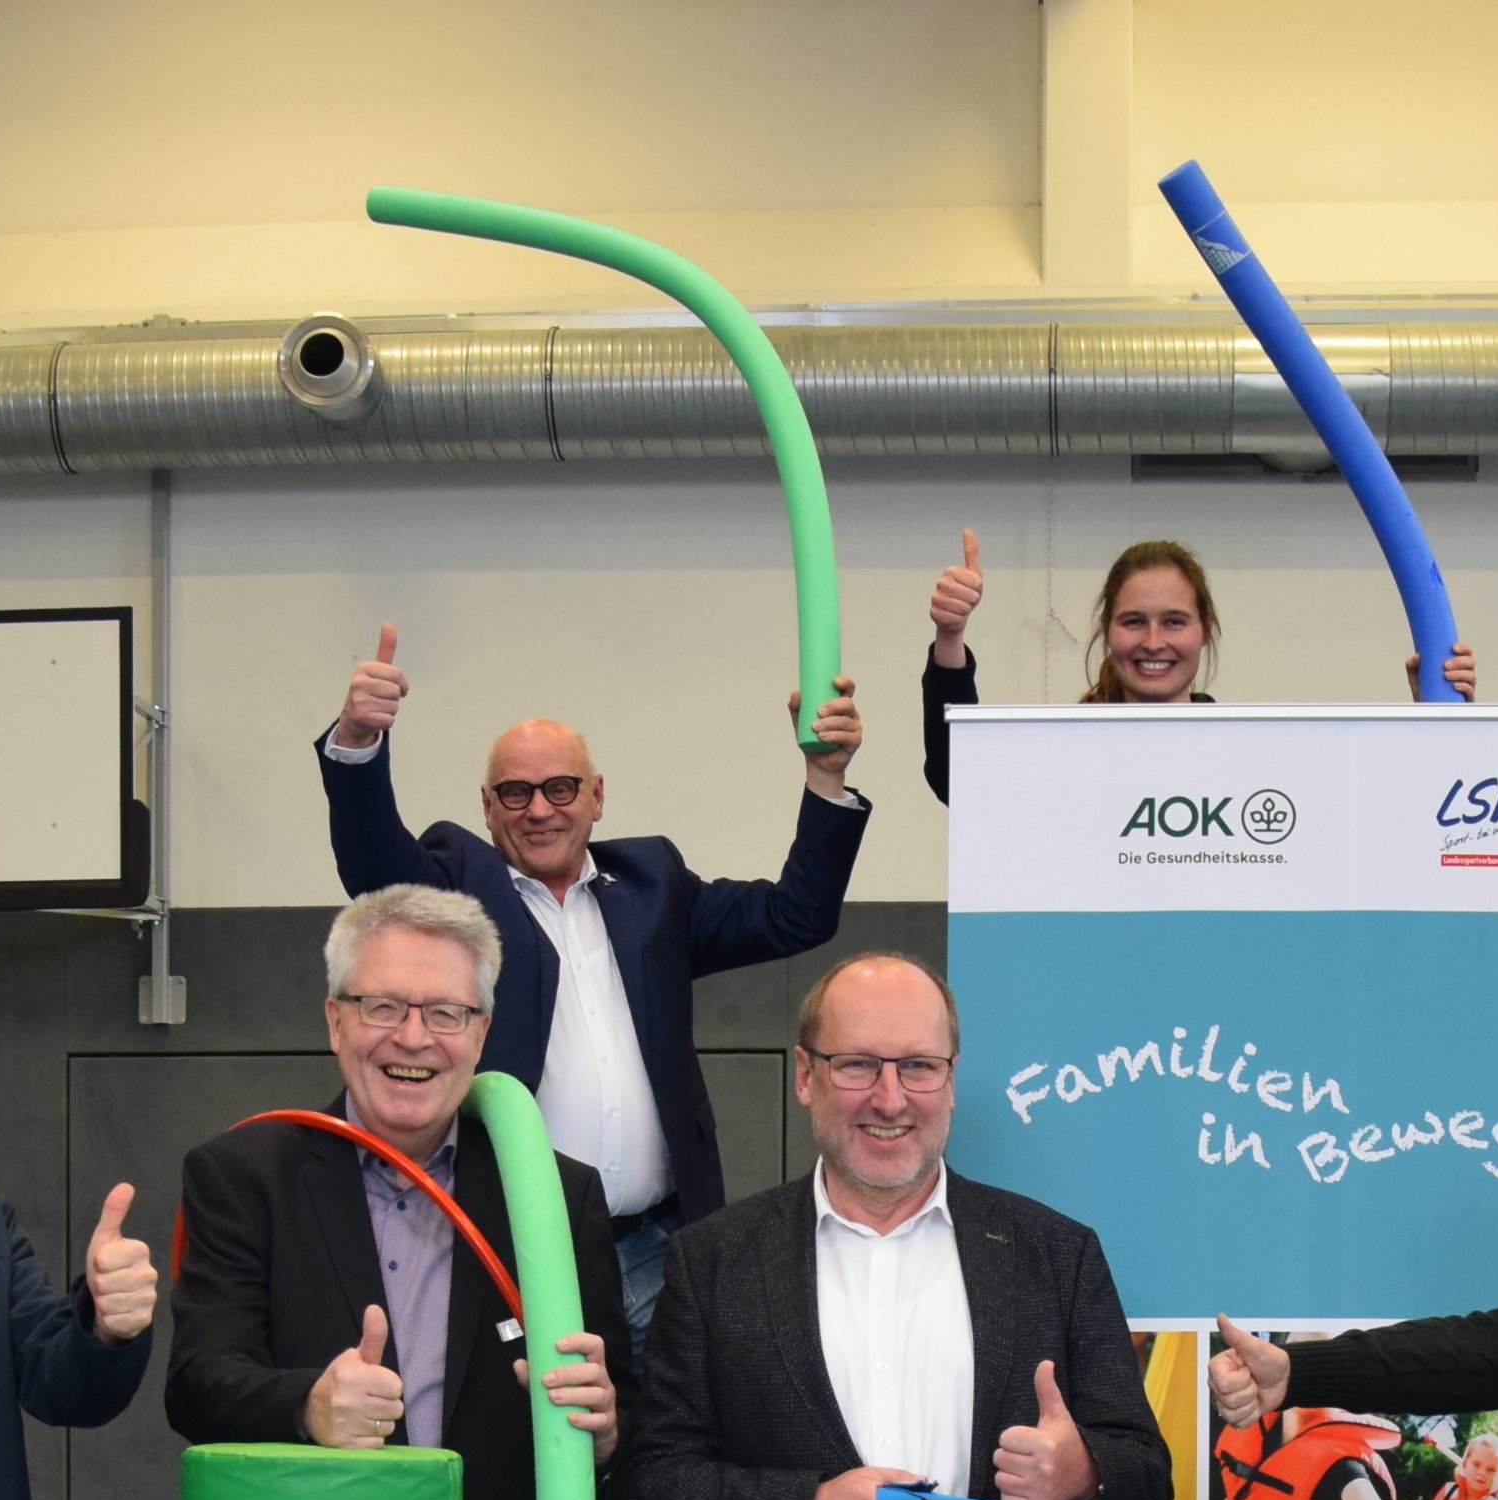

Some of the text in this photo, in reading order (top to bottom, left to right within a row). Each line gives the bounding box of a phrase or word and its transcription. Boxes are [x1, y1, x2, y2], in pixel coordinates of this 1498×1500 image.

[1119, 796, 1235, 838] AOK
[1118, 851, 1288, 865] Die Gesundheitskasse.
[1006, 1024, 1350, 1124] Familien
[1198, 1112, 1270, 1169] in
